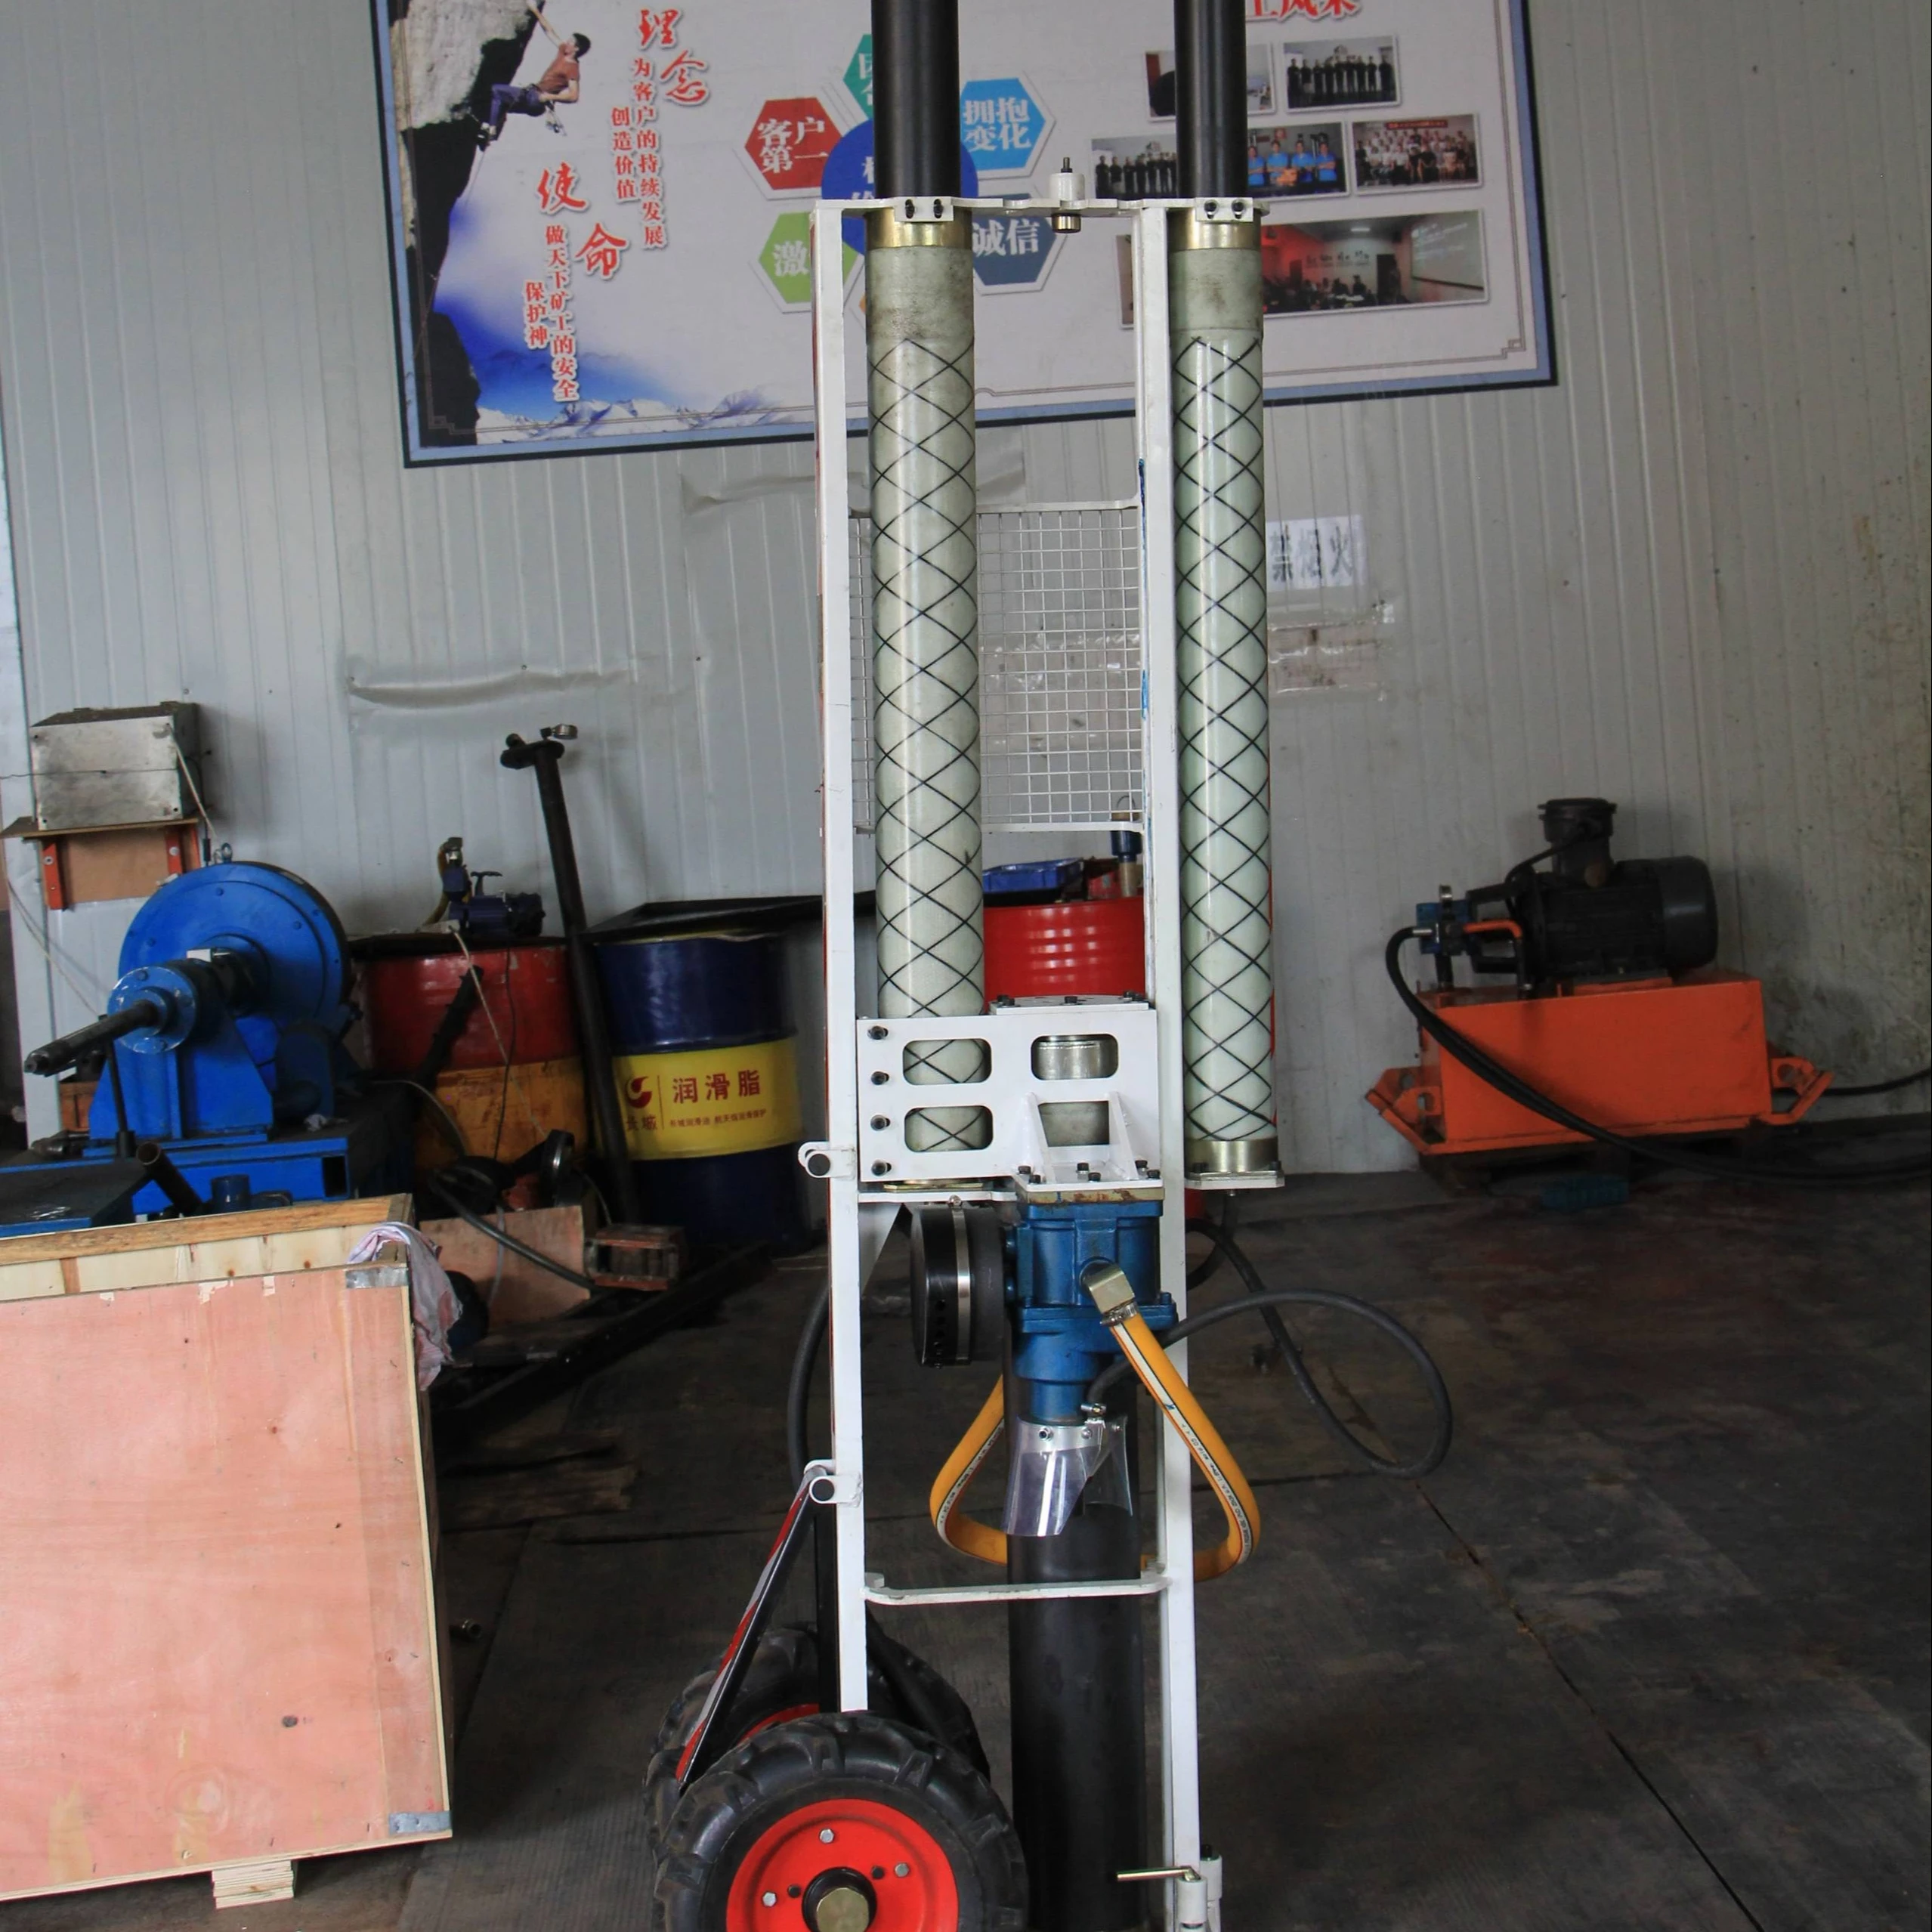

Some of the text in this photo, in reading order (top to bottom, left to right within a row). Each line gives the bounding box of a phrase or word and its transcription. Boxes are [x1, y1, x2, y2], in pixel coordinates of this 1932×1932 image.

[964, 97, 1031, 125] 拥抱
[758, 116, 825, 144] 客户
[964, 123, 1031, 151] 变化
[612, 107, 637, 199] 创造价值
[633, 58, 665, 246] 为客户的持续发展
[760, 145, 829, 174] 第一
[972, 218, 1040, 257] 诚信
[525, 282, 549, 348] 保护神
[546, 227, 578, 400] 做天下矿工的安全
[672, 1070, 761, 1104] 润滑脂
